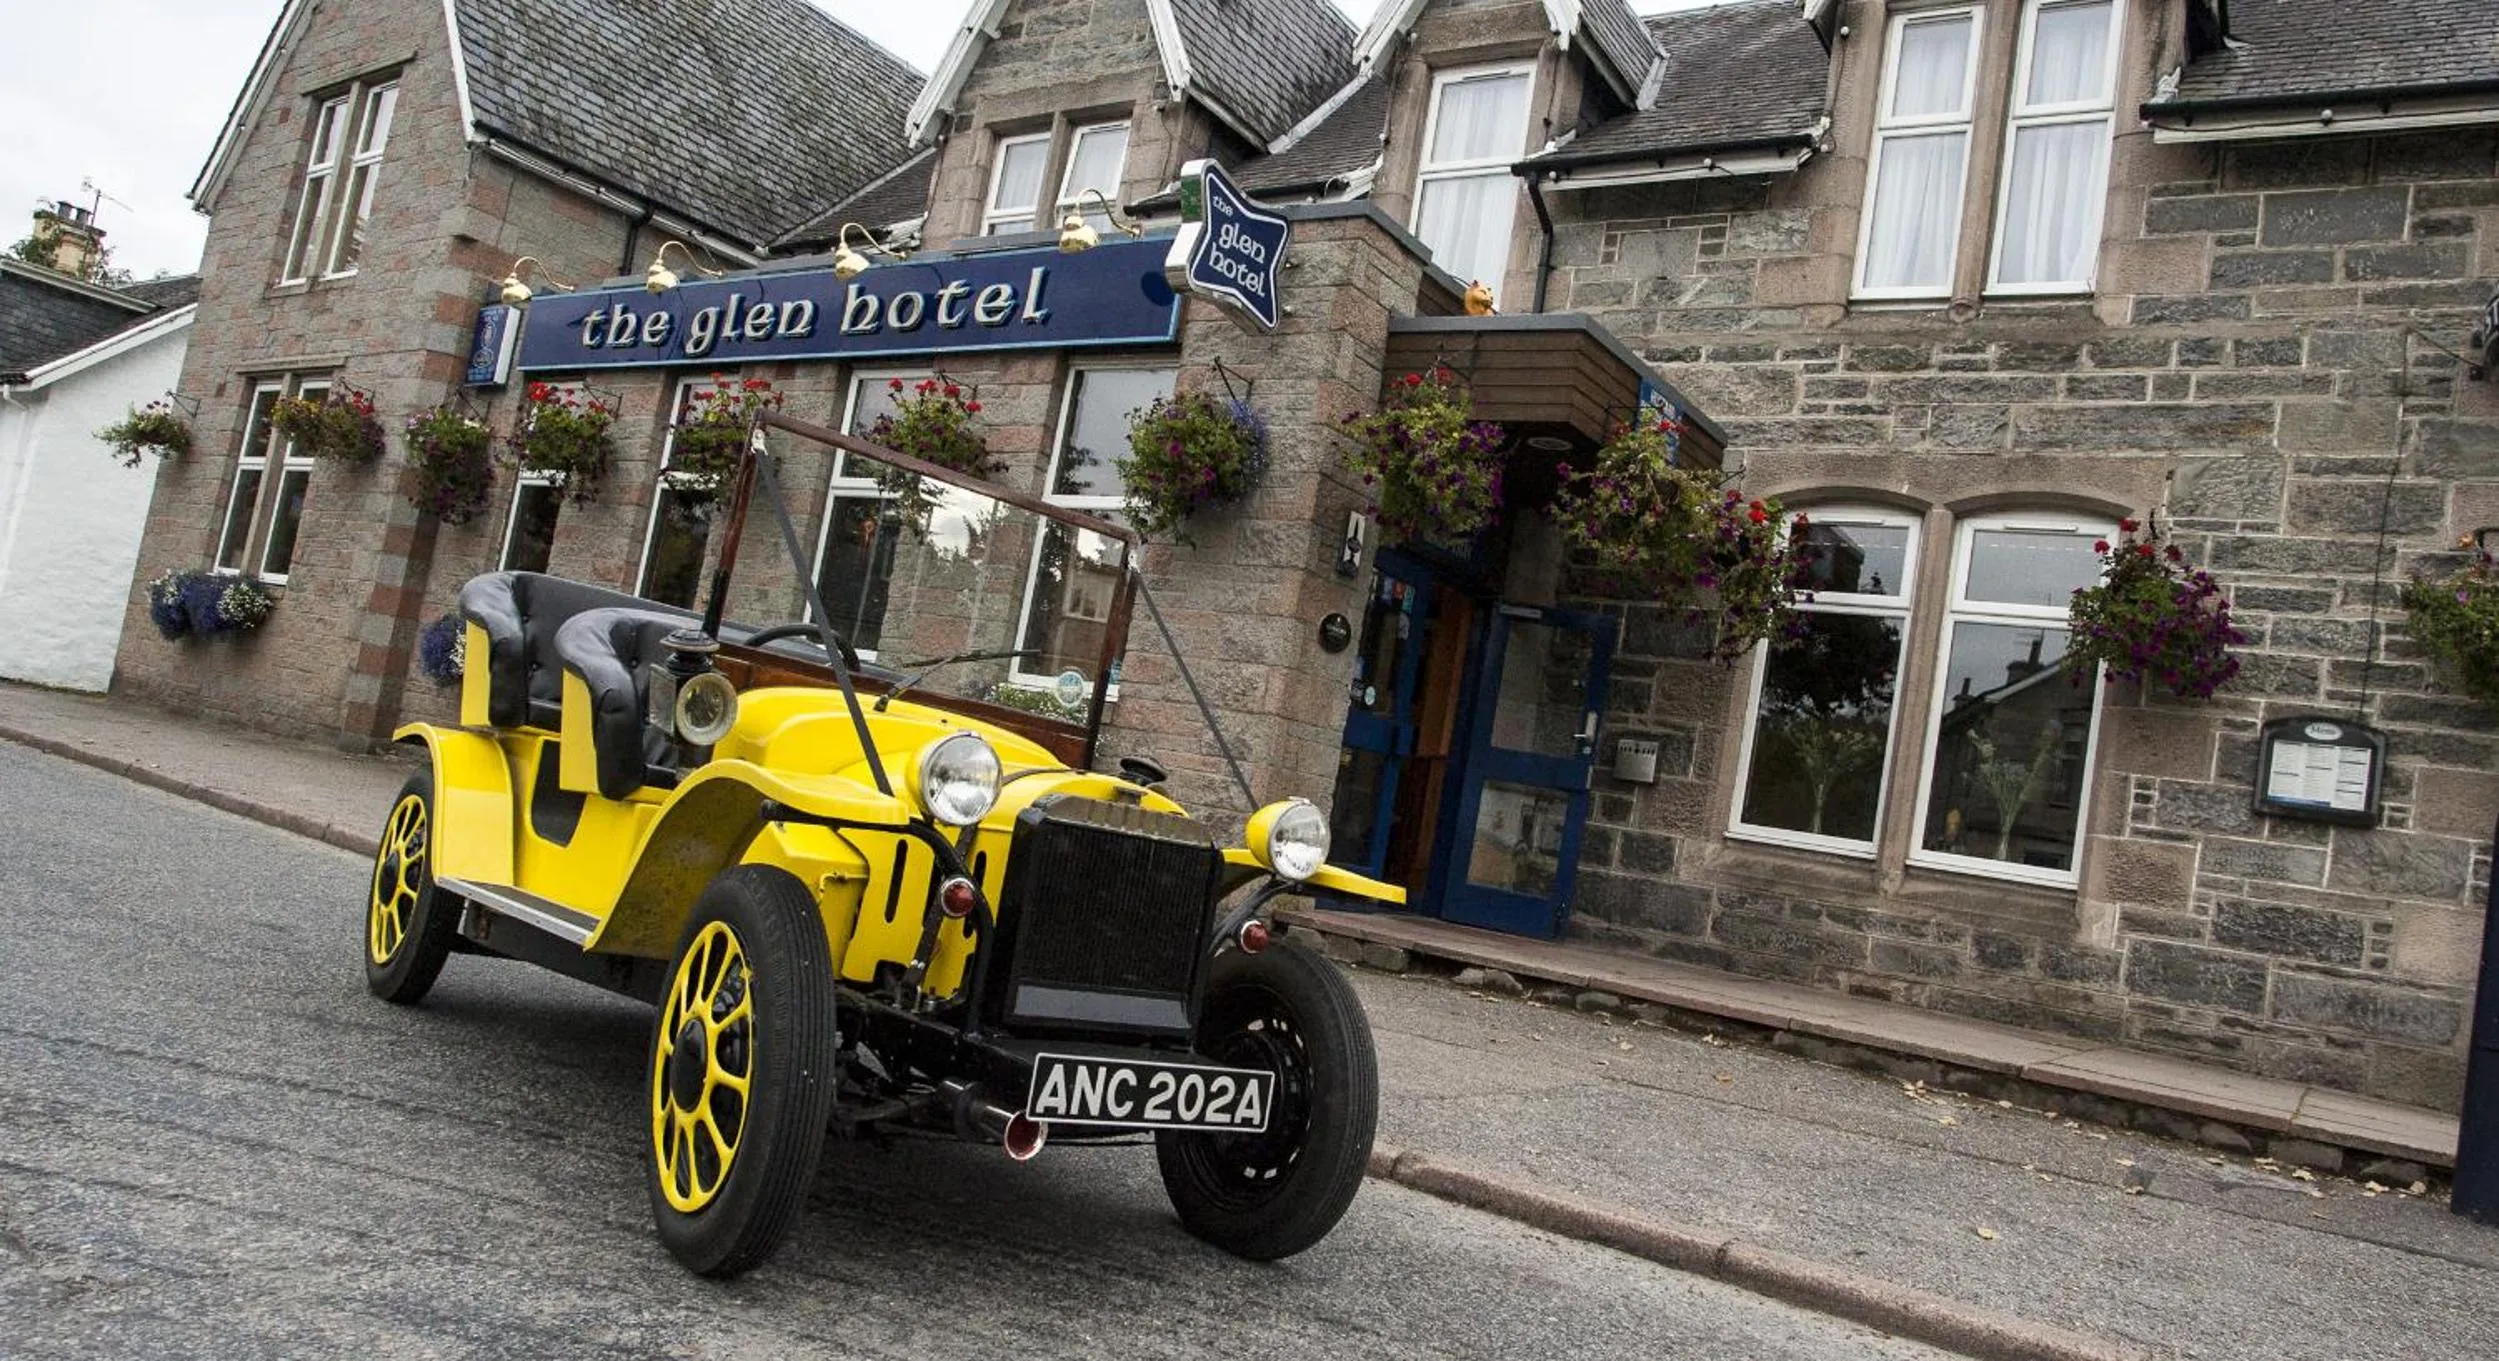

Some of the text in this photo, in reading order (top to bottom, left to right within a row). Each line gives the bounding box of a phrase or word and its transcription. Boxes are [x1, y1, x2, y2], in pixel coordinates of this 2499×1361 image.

[1213, 196, 1233, 216] the
[1209, 242, 1265, 297] hotel
[1219, 223, 1265, 263] glen
[582, 266, 1051, 357] the glen hotel
[1035, 1063, 1262, 1125] ANC 202A
